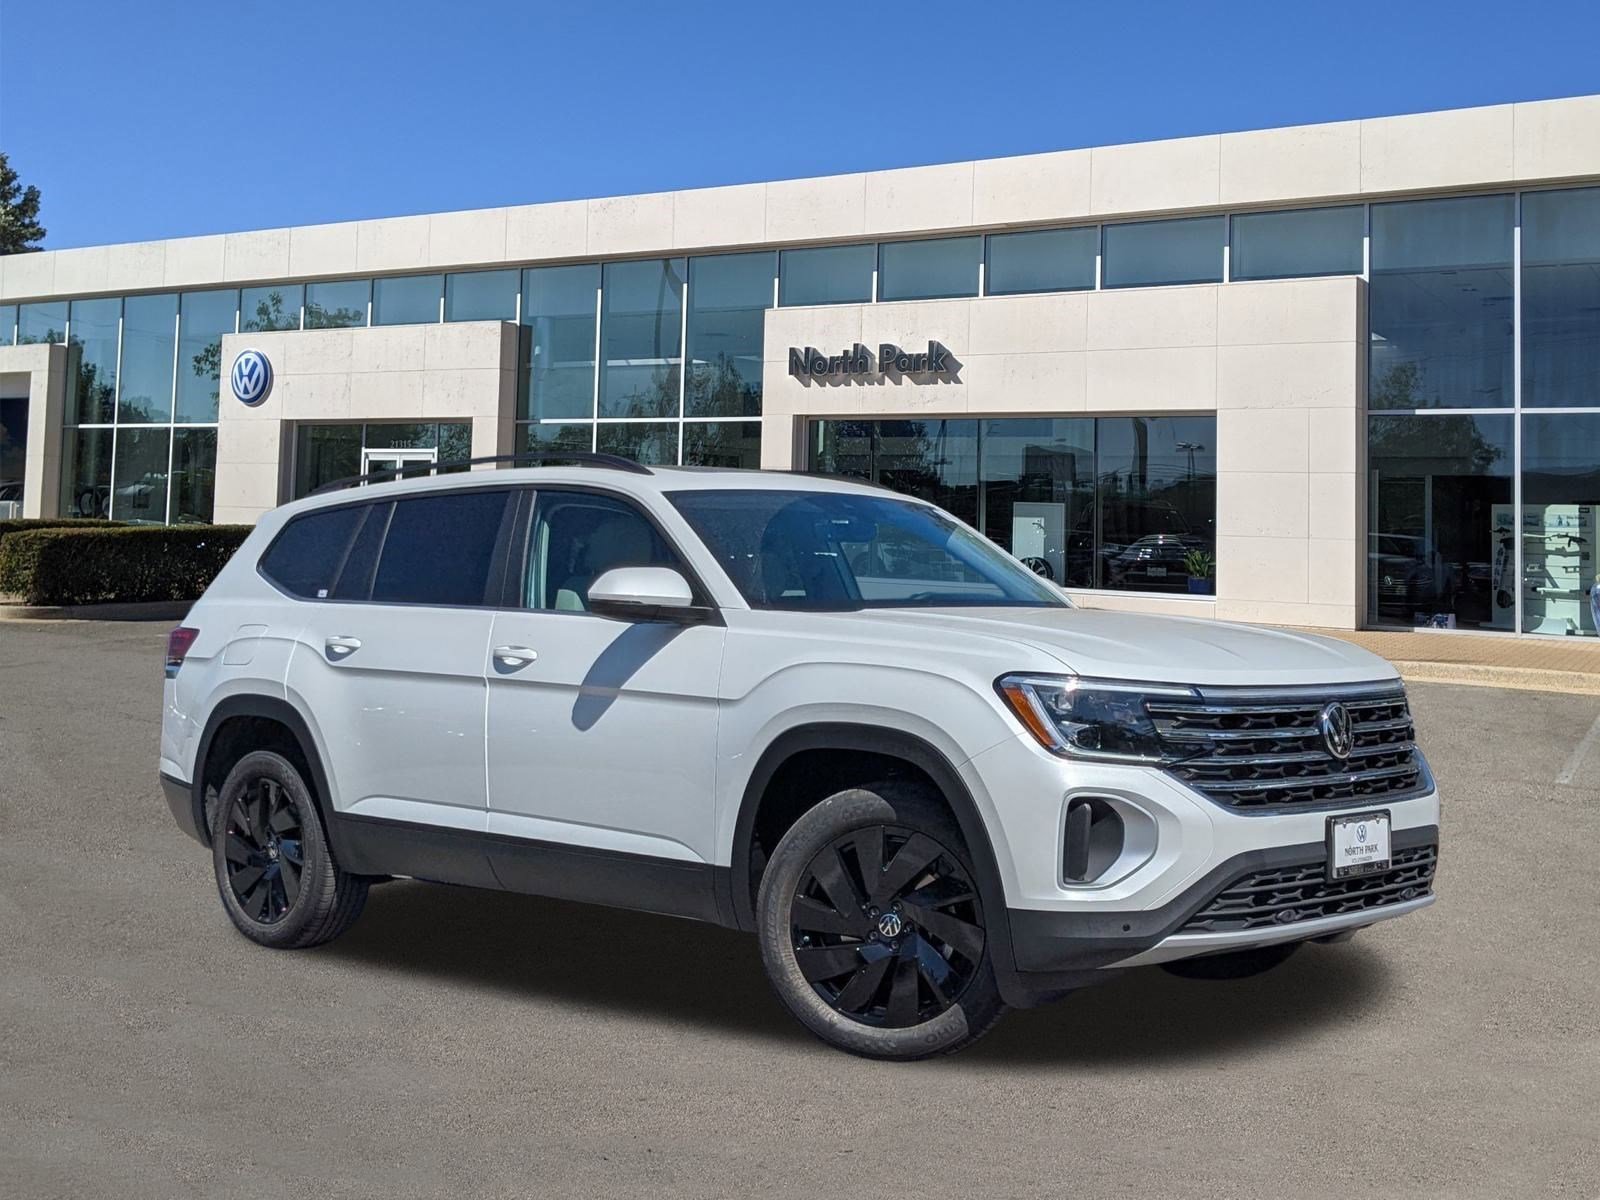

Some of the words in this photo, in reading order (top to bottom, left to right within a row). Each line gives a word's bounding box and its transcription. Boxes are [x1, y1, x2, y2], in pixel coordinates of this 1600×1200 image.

[232, 351, 267, 402] VW
[788, 343, 869, 375] North
[878, 340, 947, 373] Park
[1323, 702, 1352, 759] VW
[1344, 846, 1364, 857] NORTH
[1365, 843, 1379, 854] PARK
